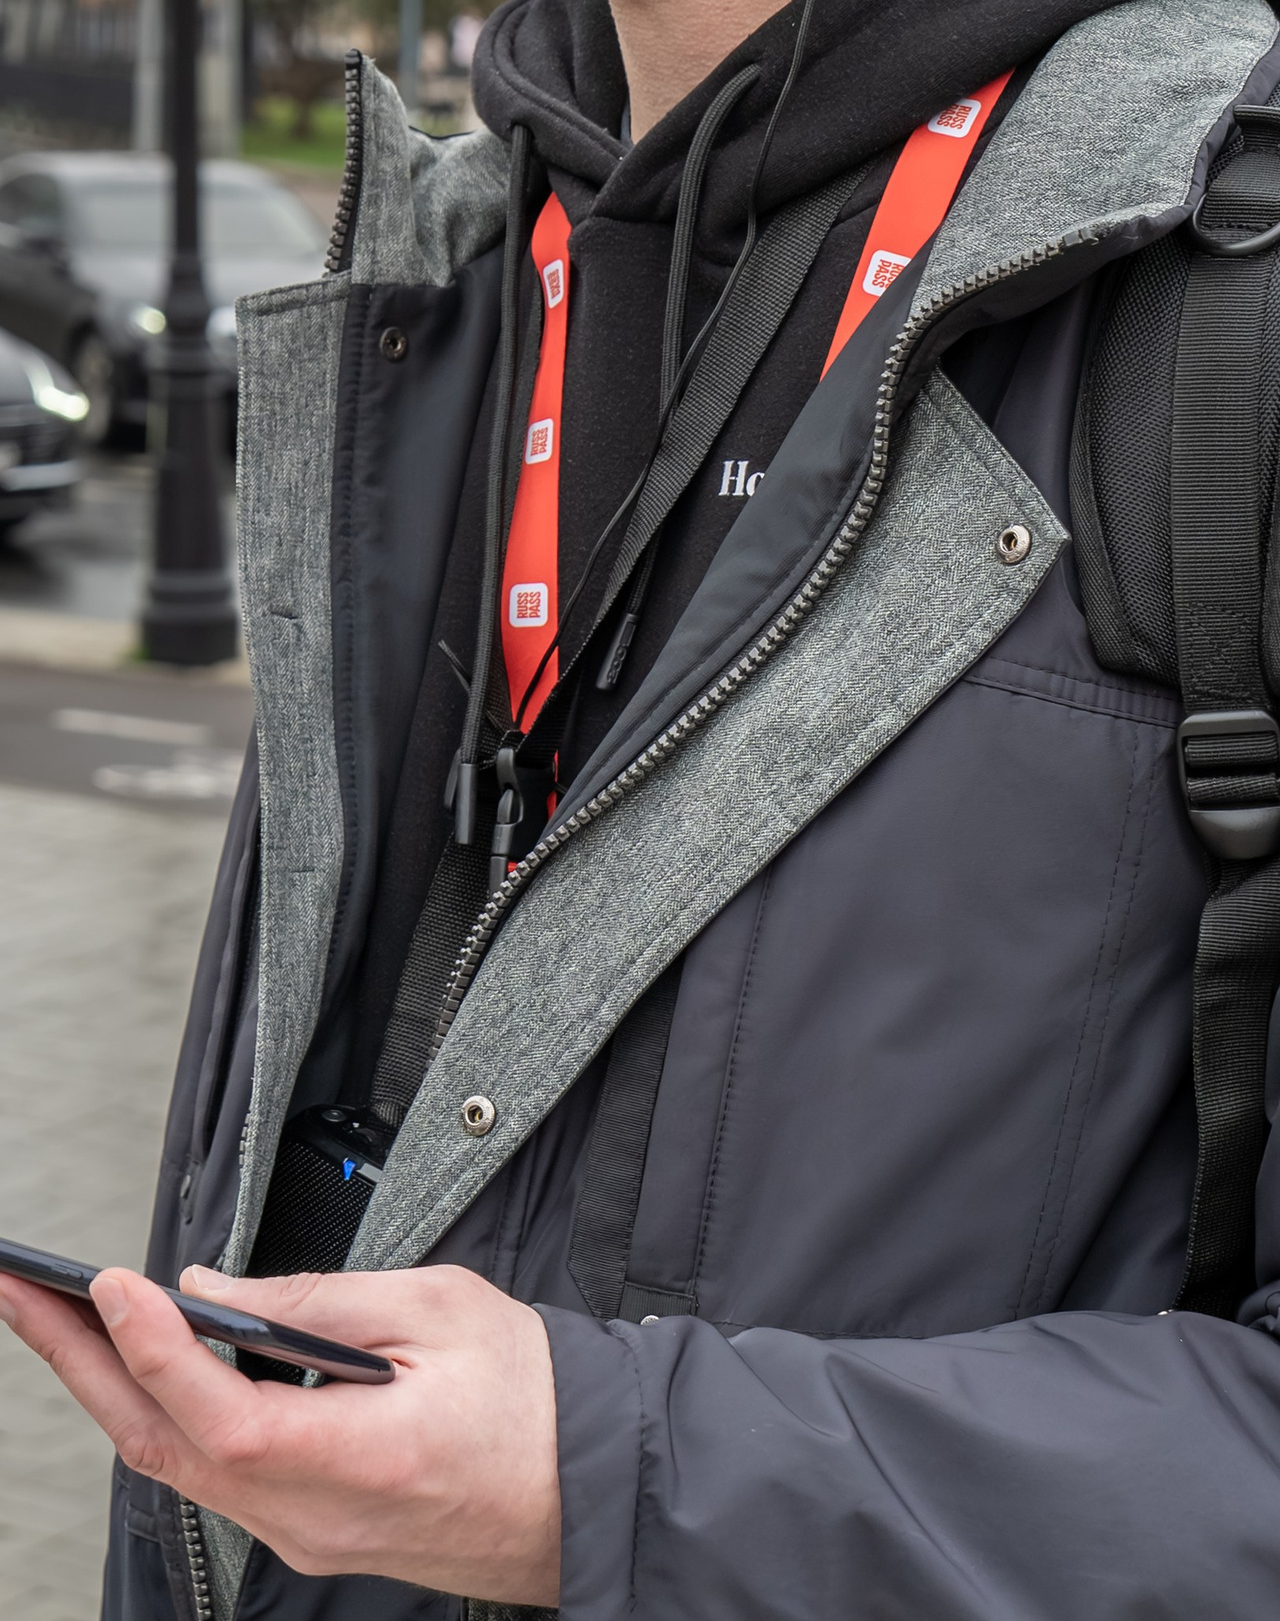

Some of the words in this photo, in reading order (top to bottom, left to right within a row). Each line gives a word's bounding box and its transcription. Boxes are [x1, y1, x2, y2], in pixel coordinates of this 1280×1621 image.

[949, 105, 973, 130] RUSS
[872, 259, 892, 288] PASS
[517, 592, 529, 619] RUSS
[529, 591, 541, 618] PASS
